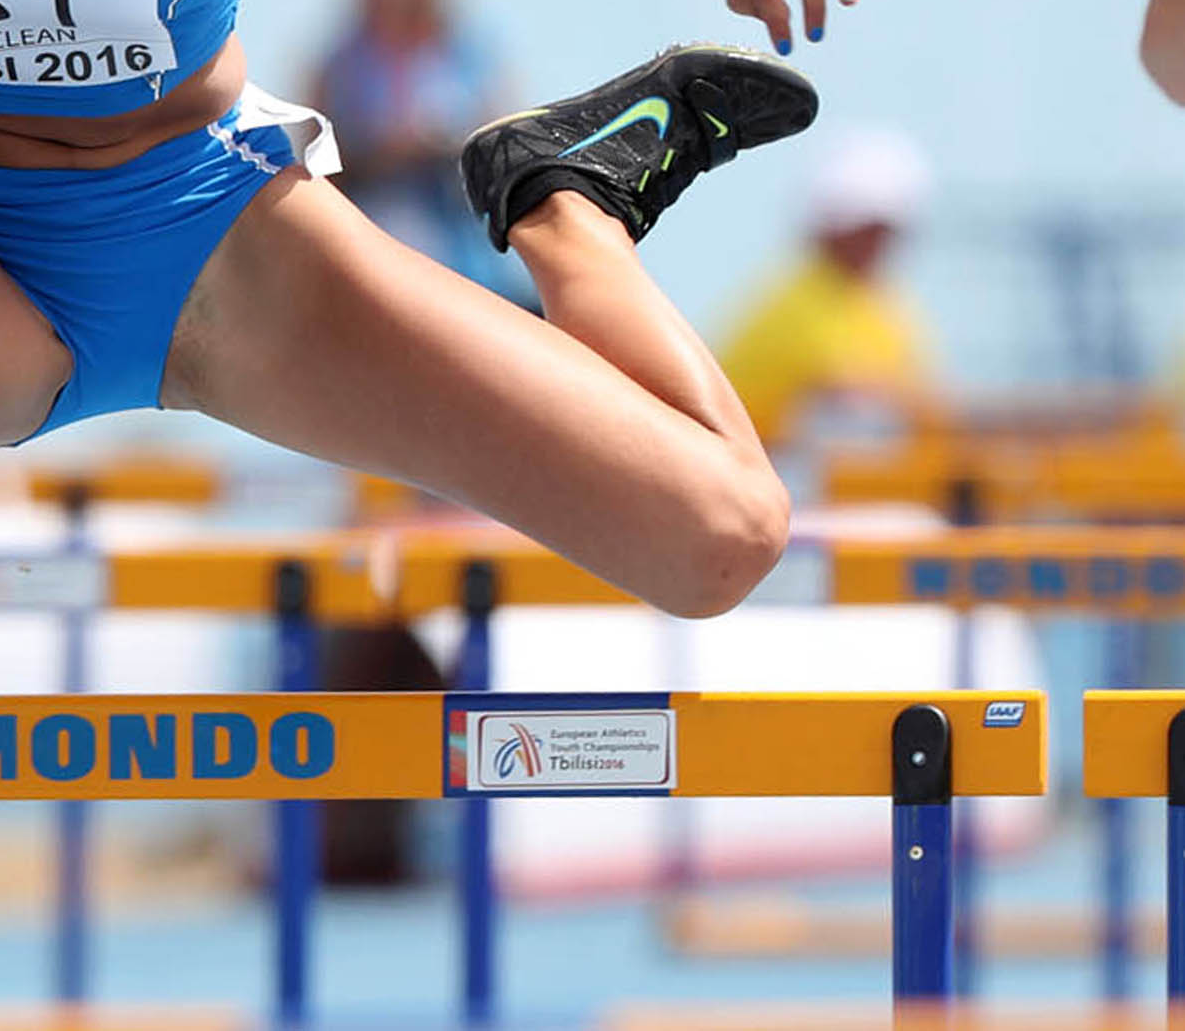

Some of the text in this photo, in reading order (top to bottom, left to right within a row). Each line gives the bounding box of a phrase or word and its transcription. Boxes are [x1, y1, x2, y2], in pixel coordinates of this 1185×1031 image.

[32, 43, 153, 83] 2016
[550, 728, 646, 740] European Athletics
[550, 741, 660, 753] Youth Championships
